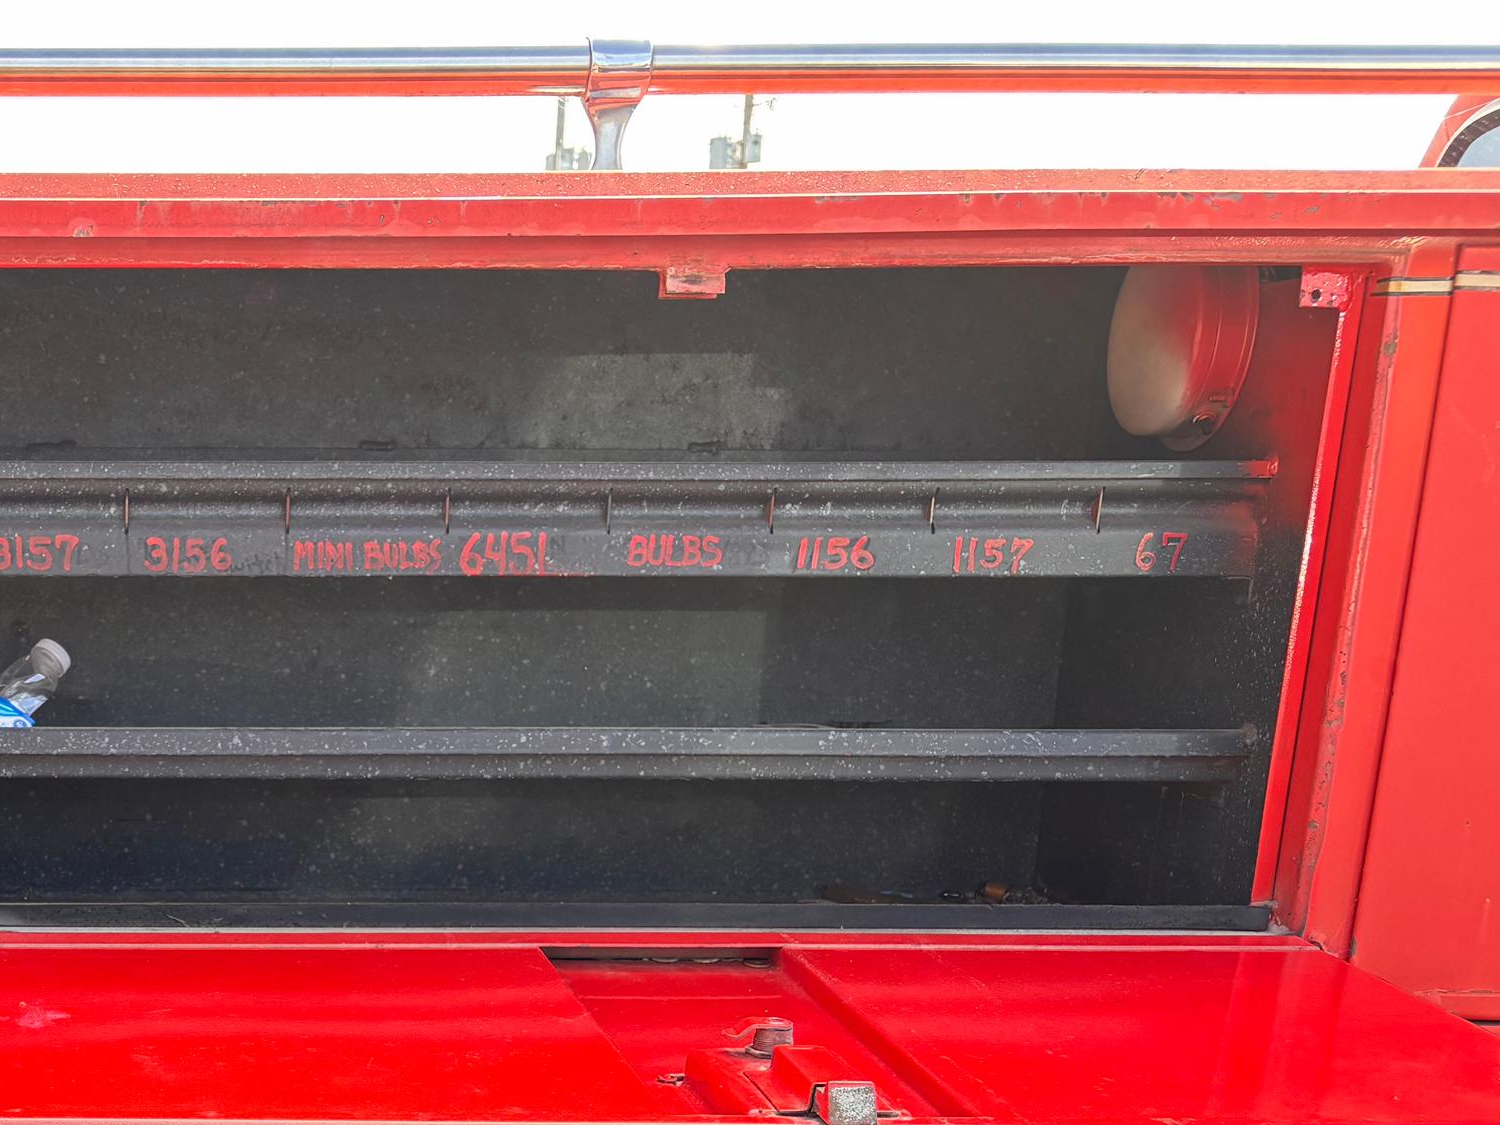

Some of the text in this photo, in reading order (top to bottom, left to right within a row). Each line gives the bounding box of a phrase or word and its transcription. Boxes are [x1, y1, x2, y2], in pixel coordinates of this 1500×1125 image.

[143, 535, 234, 575] 3156
[292, 538, 354, 574] MINI
[362, 537, 443, 576] BULBS
[627, 532, 723, 568] BULBS
[796, 534, 875, 572] 1156
[953, 534, 1035, 575] 1157
[1135, 530, 1189, 573] 67
